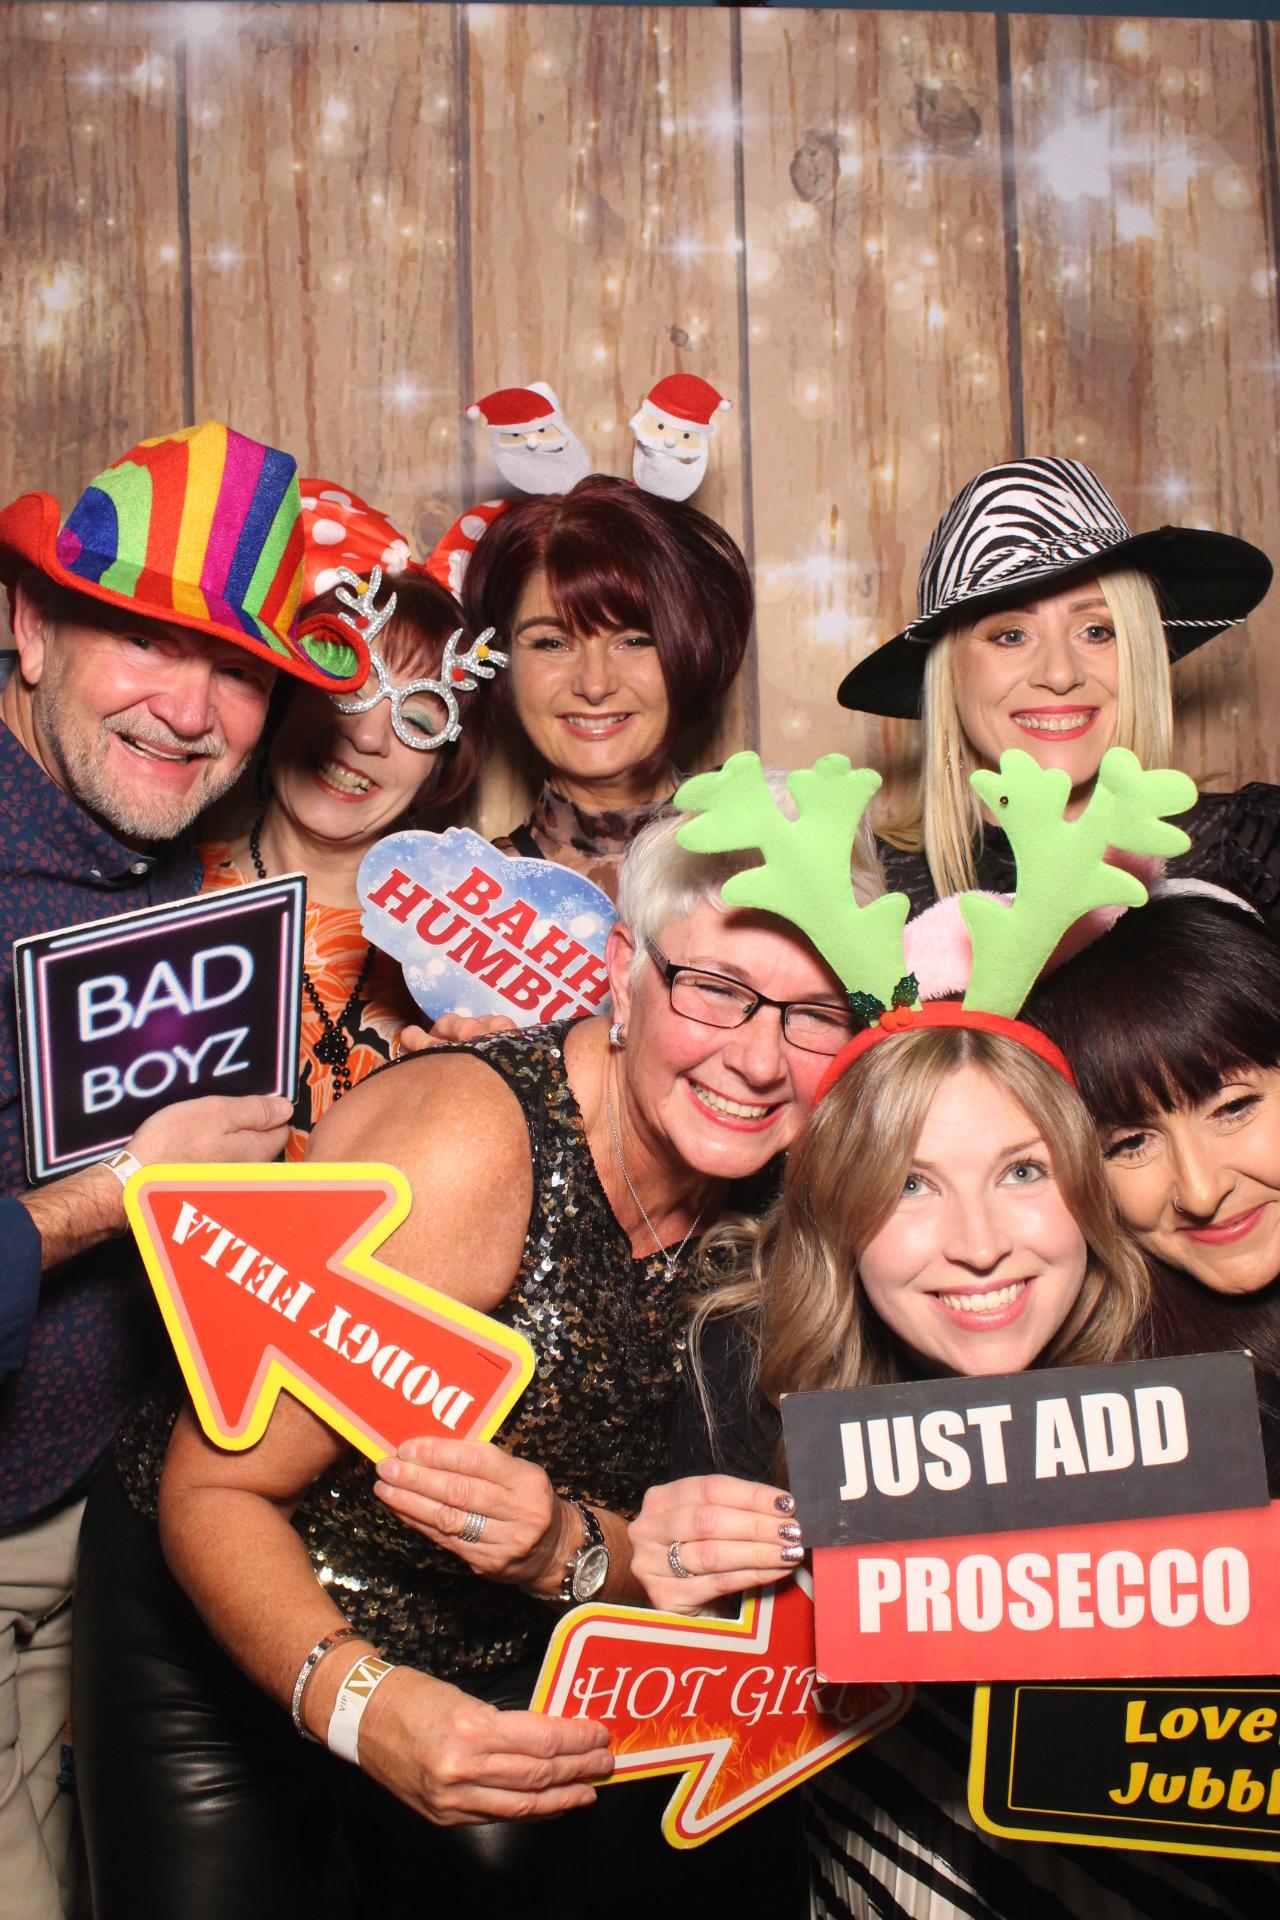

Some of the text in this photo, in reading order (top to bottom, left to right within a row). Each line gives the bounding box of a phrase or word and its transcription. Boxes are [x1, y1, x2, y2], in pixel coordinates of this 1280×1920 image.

[446, 866, 610, 1007] BAHH
[78, 945, 254, 1043] BAD
[82, 1027, 250, 1115] BOYZ
[172, 1201, 476, 1431] DODGY FELLA
[839, 1386, 1190, 1502] JUST ADD
[857, 1546, 1251, 1634] PROSECCO
[571, 1665, 728, 1719] HOT
[1124, 1700, 1280, 1745] Love
